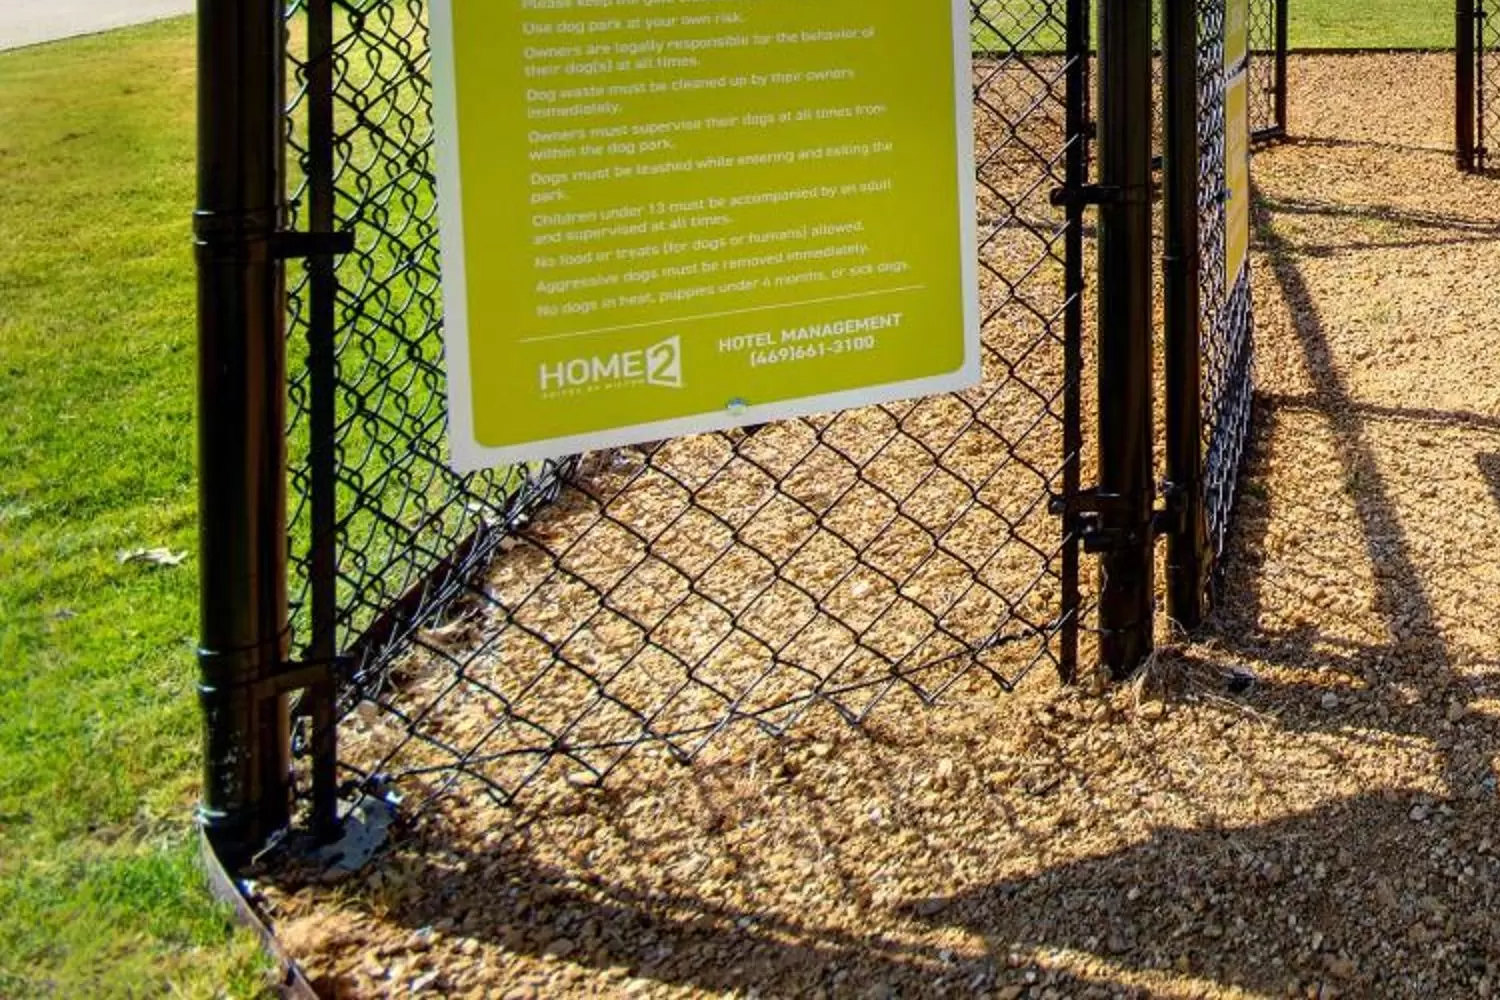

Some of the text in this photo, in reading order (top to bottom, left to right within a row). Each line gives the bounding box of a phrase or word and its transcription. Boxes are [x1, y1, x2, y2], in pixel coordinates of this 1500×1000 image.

[719, 312, 903, 352] HOTEL MANAGEMENT
[750, 334, 875, 367] (469)661-3100
